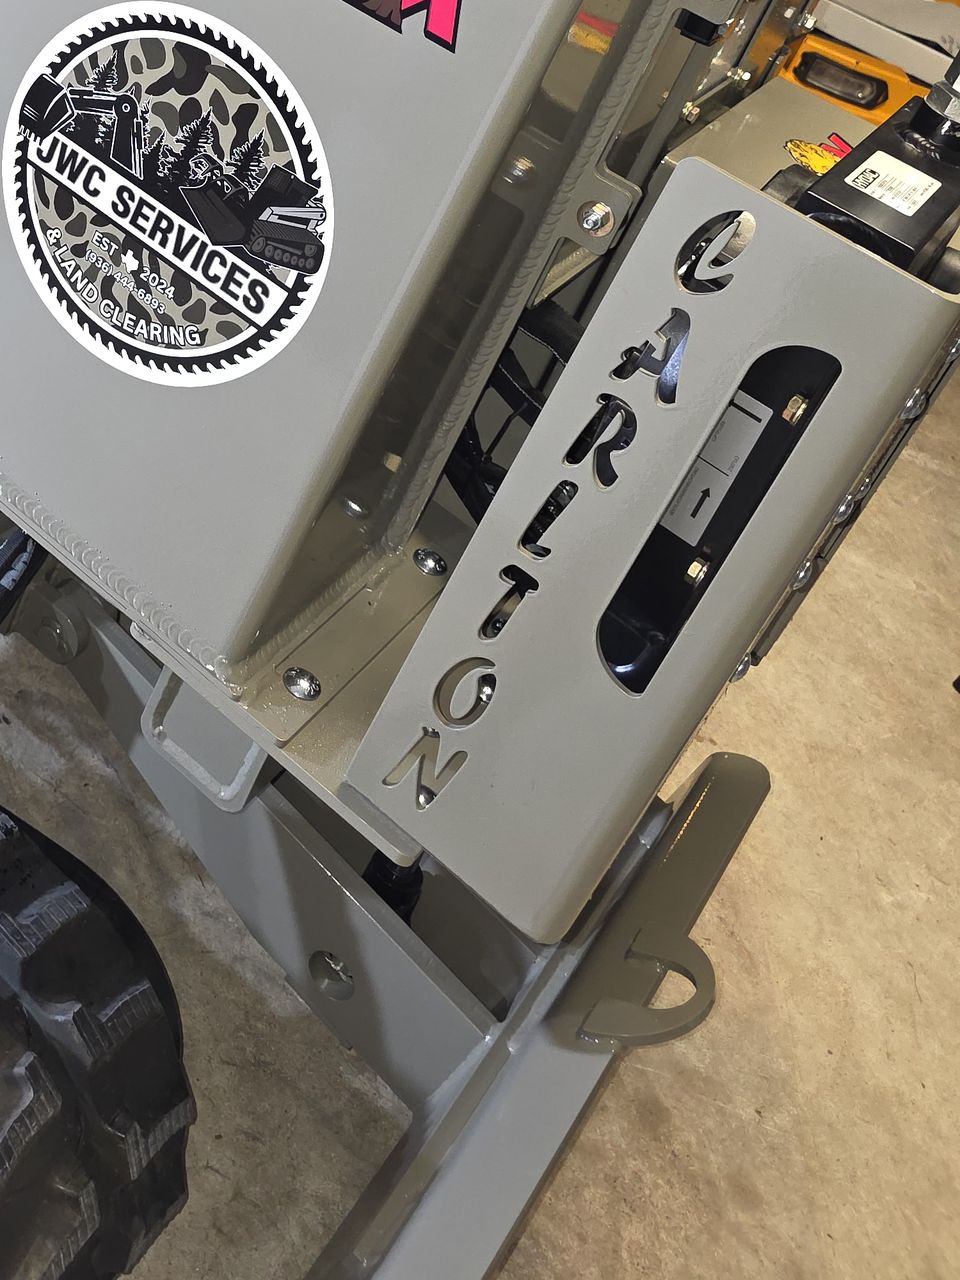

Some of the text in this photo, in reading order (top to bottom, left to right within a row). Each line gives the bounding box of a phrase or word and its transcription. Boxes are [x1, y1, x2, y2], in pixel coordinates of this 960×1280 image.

[36, 136, 271, 315] JWC SERVICES
[85, 249, 166, 314] (936) 444-6893
[92, 230, 176, 300] EST 2024
[46, 227, 201, 346] & LAND CLEARING
[381, 210, 757, 812] CARLTON
